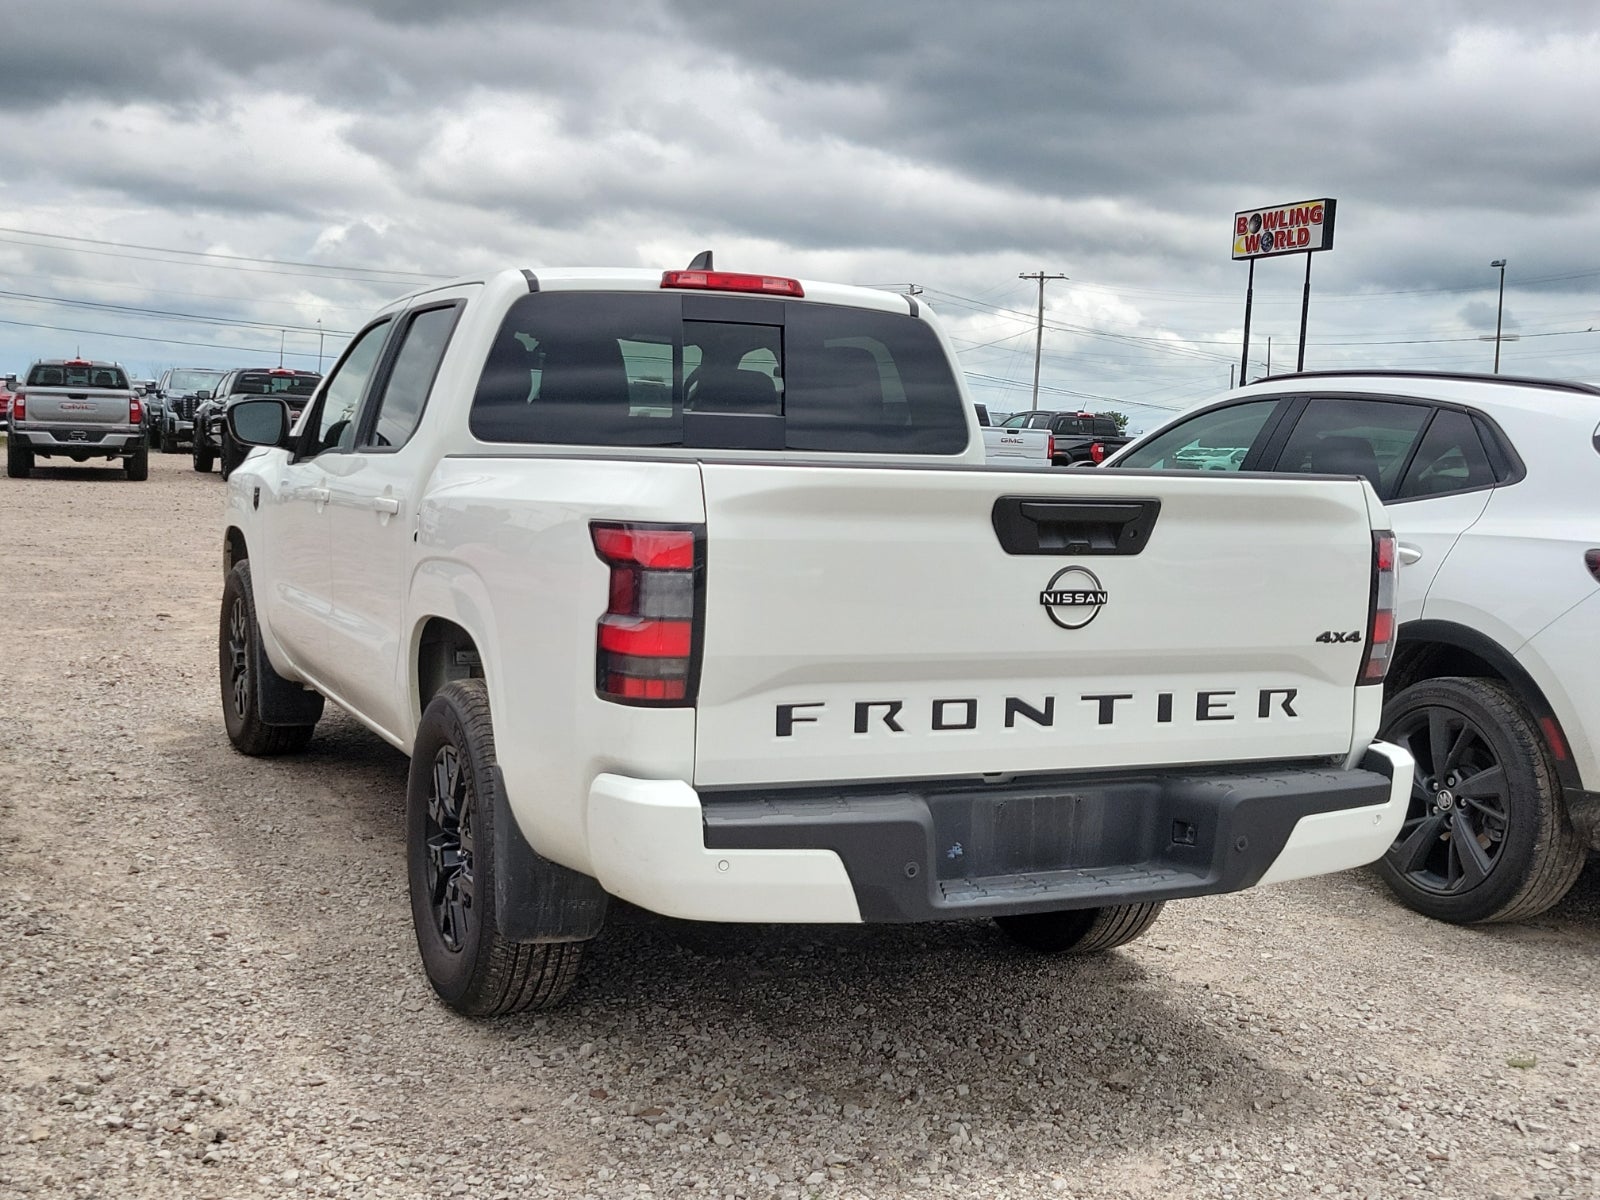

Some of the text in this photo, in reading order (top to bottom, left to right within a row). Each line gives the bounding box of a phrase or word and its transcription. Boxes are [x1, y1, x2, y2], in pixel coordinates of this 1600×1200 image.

[1236, 205, 1324, 236] BOWLING
[1245, 228, 1311, 254] WORLD
[1042, 592, 1107, 603] NISSAN
[775, 688, 1299, 737] FRONTIER
